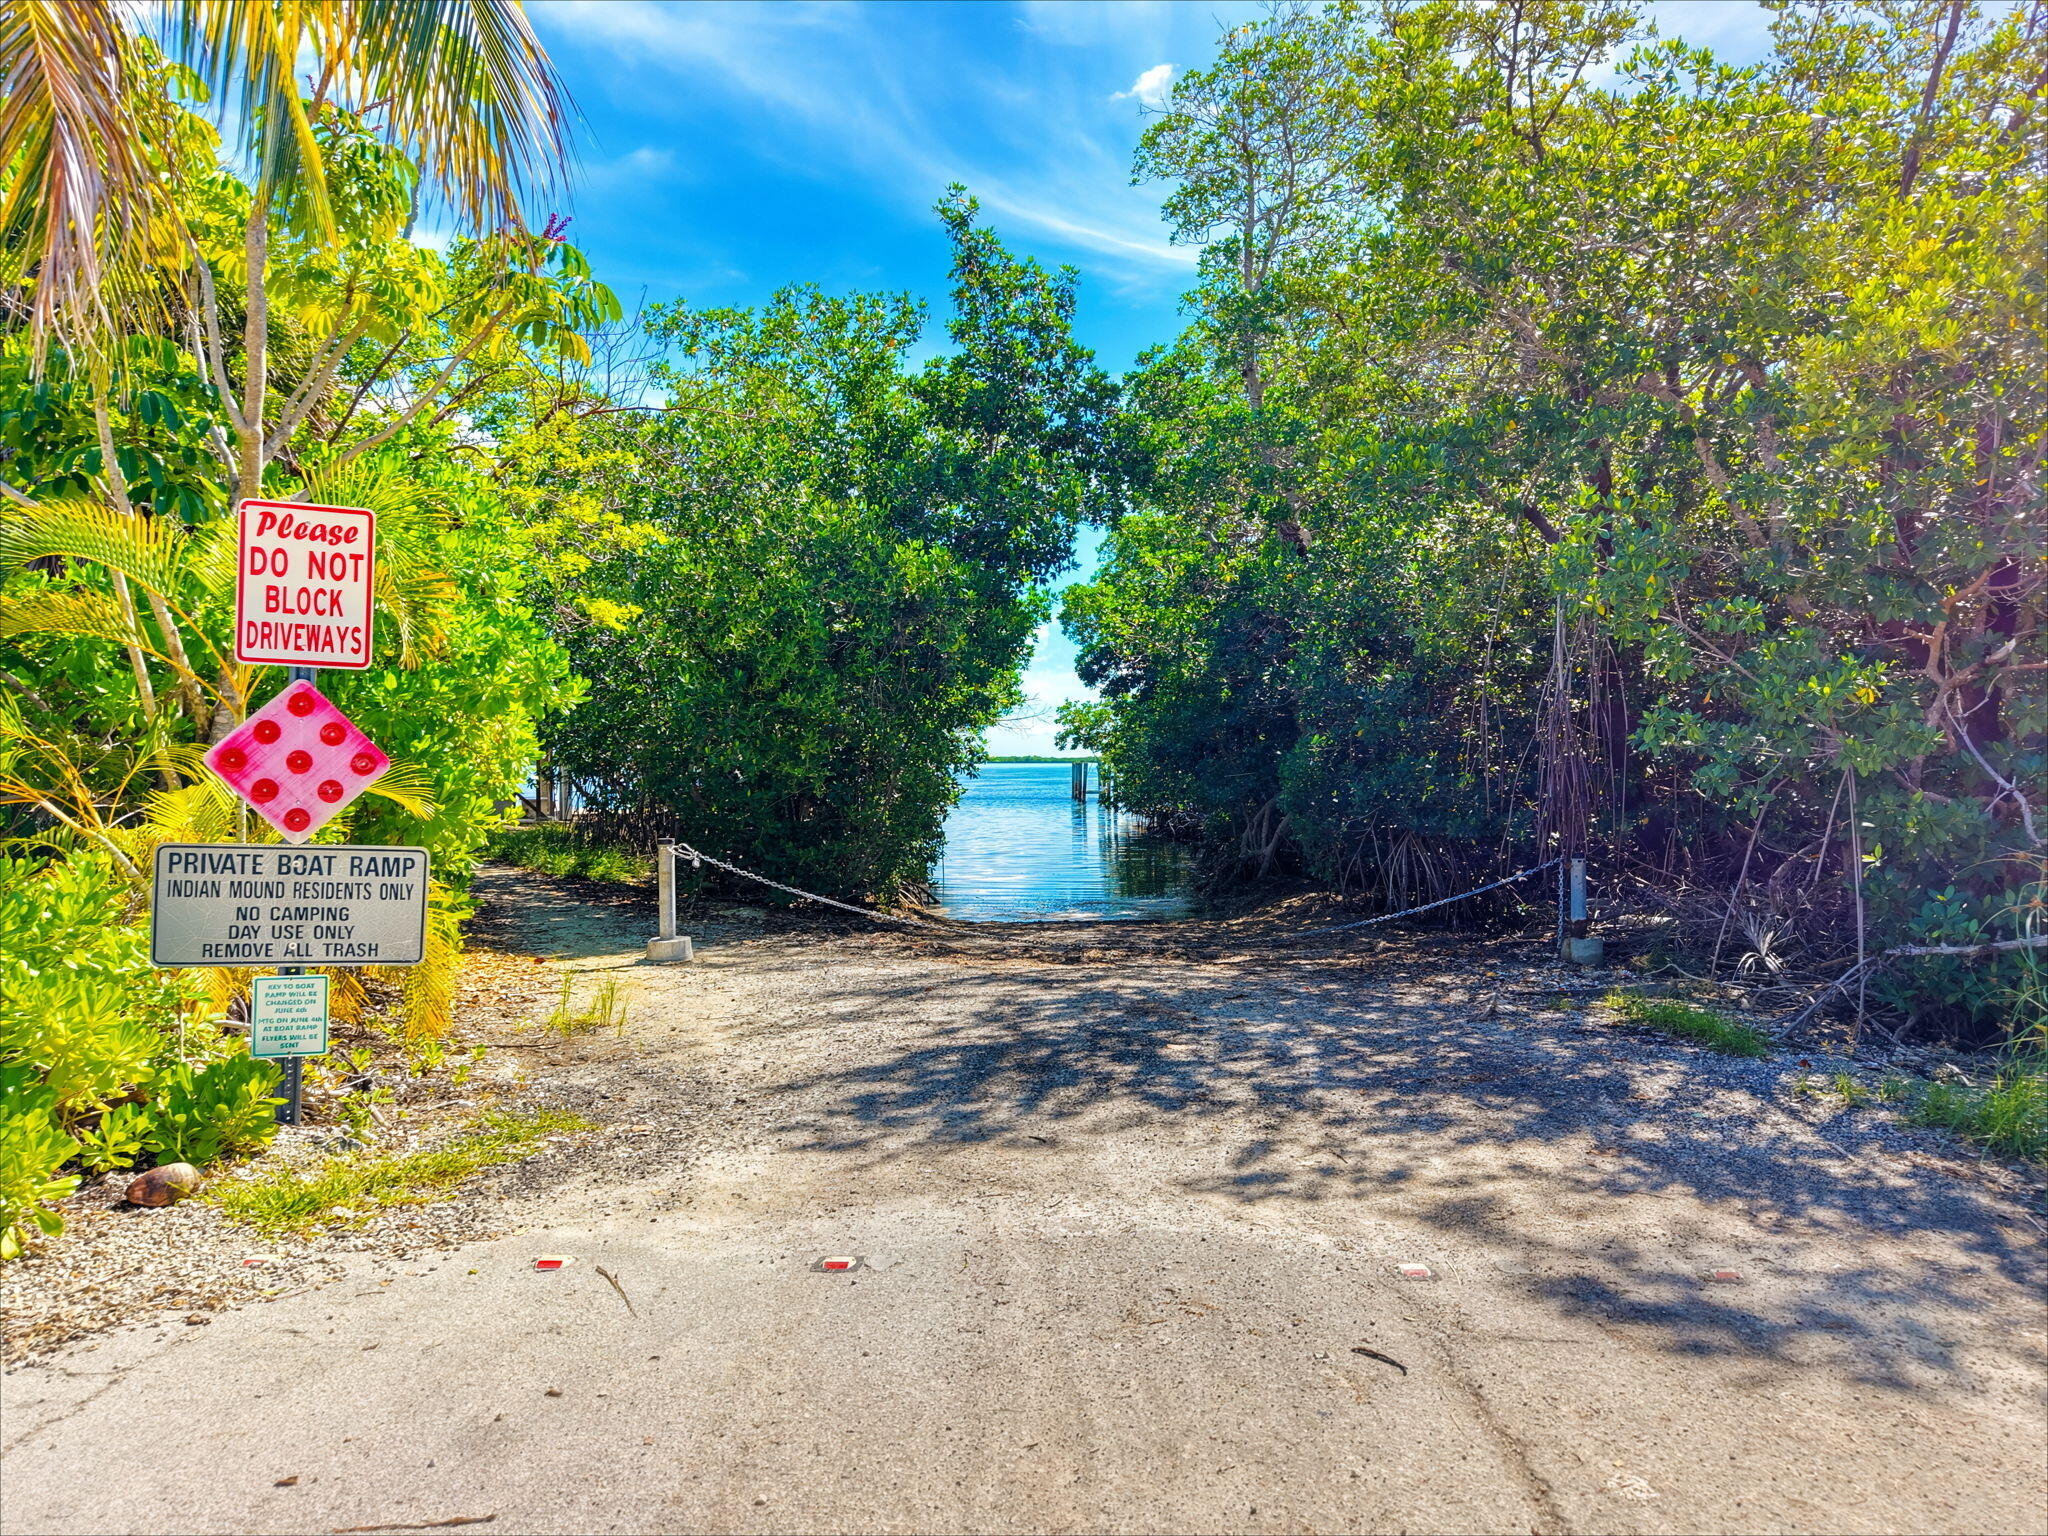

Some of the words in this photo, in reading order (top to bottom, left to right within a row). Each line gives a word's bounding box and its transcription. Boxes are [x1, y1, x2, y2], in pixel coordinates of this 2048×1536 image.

[256, 511, 359, 546] Please
[250, 546, 288, 577] DO
[308, 550, 364, 582] NOT
[265, 585, 343, 617] BLOCK
[246, 620, 362, 655] DRIVEWAYS
[168, 852, 264, 875] PRIVATE
[277, 854, 337, 876] BOAT
[349, 856, 415, 877] RAMP
[167, 879, 220, 898] INDIAN
[229, 880, 285, 898] MOUND
[293, 881, 372, 900] RESIDENTS
[379, 883, 414, 900] ONLY
[236, 906, 260, 921] NO
[270, 906, 350, 921] CAMPING
[228, 925, 261, 939] DAY
[271, 925, 304, 939] USE
[313, 925, 355, 939] ONLY
[202, 943, 273, 958] REMOVE
[283, 943, 313, 957] ALL
[322, 943, 379, 957] TRASH
